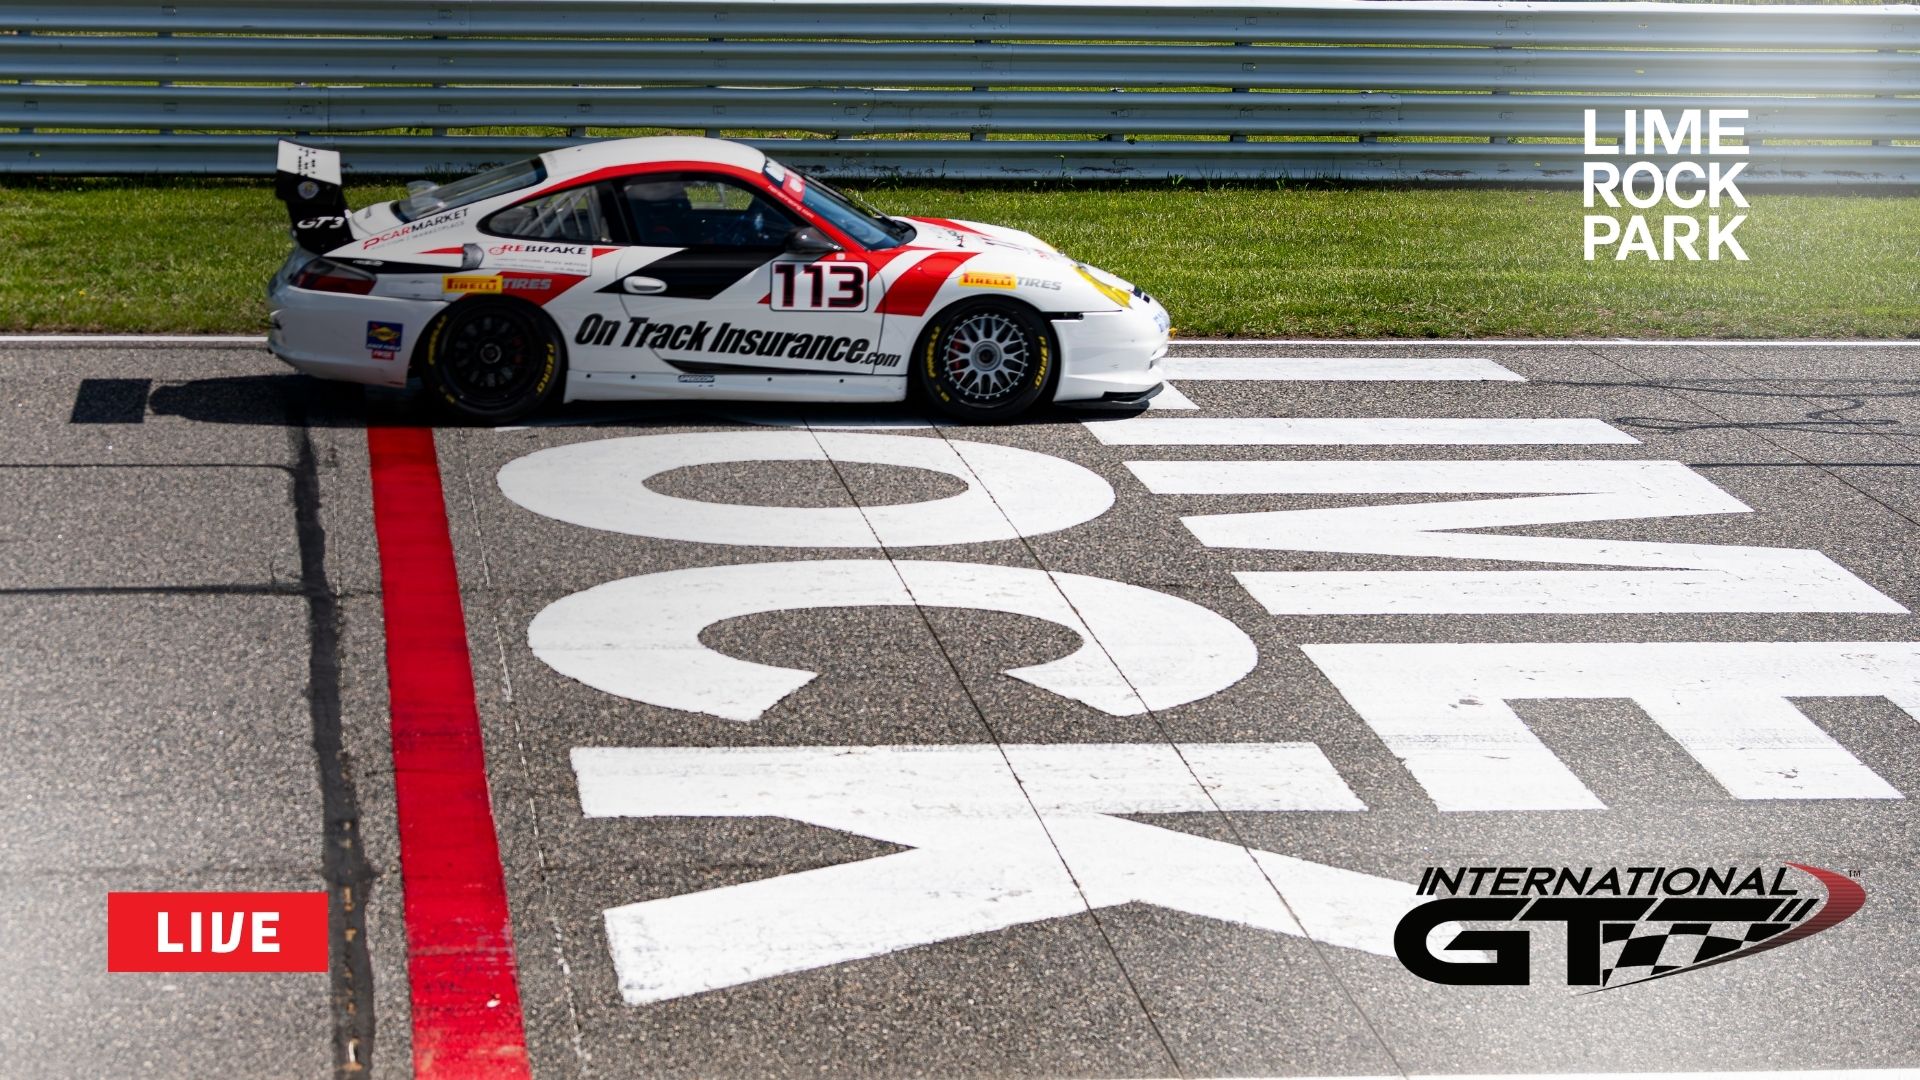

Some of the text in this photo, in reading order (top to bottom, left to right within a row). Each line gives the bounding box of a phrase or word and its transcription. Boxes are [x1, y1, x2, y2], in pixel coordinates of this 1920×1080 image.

[297, 216, 345, 229] GT3
[500, 244, 587, 255] REBRAKE
[446, 277, 553, 290] PIRELLI TIRES
[774, 263, 865, 308] 113
[963, 273, 1062, 291] PIRELLI TIRES
[574, 312, 902, 369] On Track Insurance.com
[495, 426, 1494, 1006] OCK
